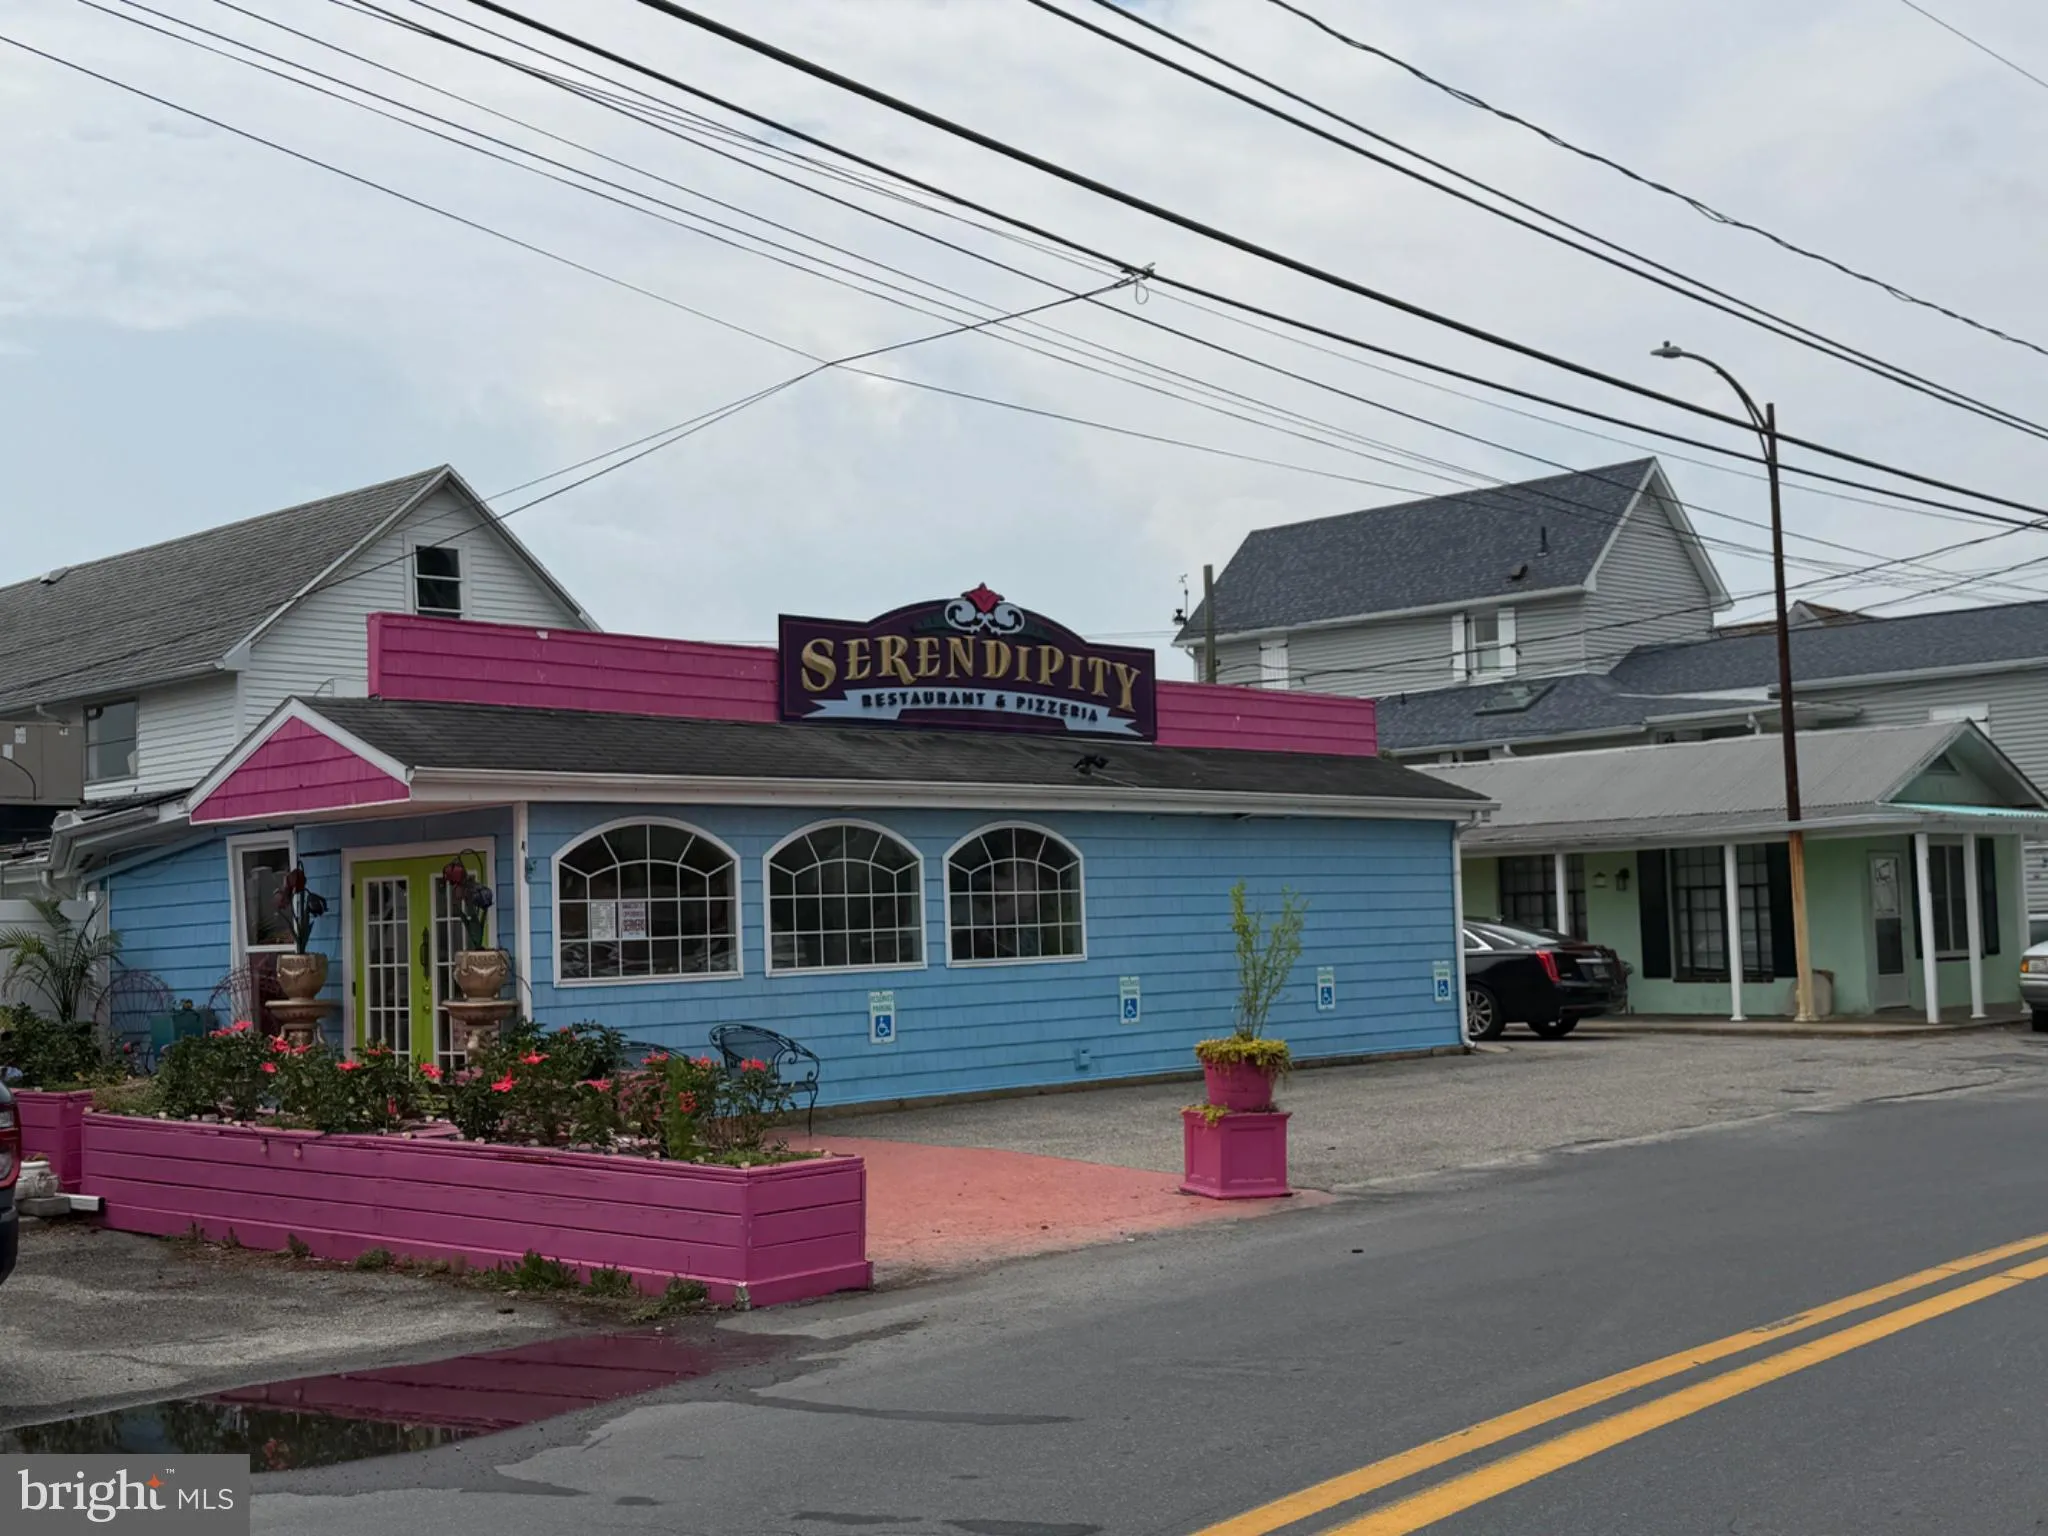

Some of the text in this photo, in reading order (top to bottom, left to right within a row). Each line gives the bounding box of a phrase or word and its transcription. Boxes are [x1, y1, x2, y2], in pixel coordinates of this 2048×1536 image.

[801, 635, 1141, 712] SERENDIPITY
[862, 692, 1098, 722] RESTAURANT & PIZZERIA
